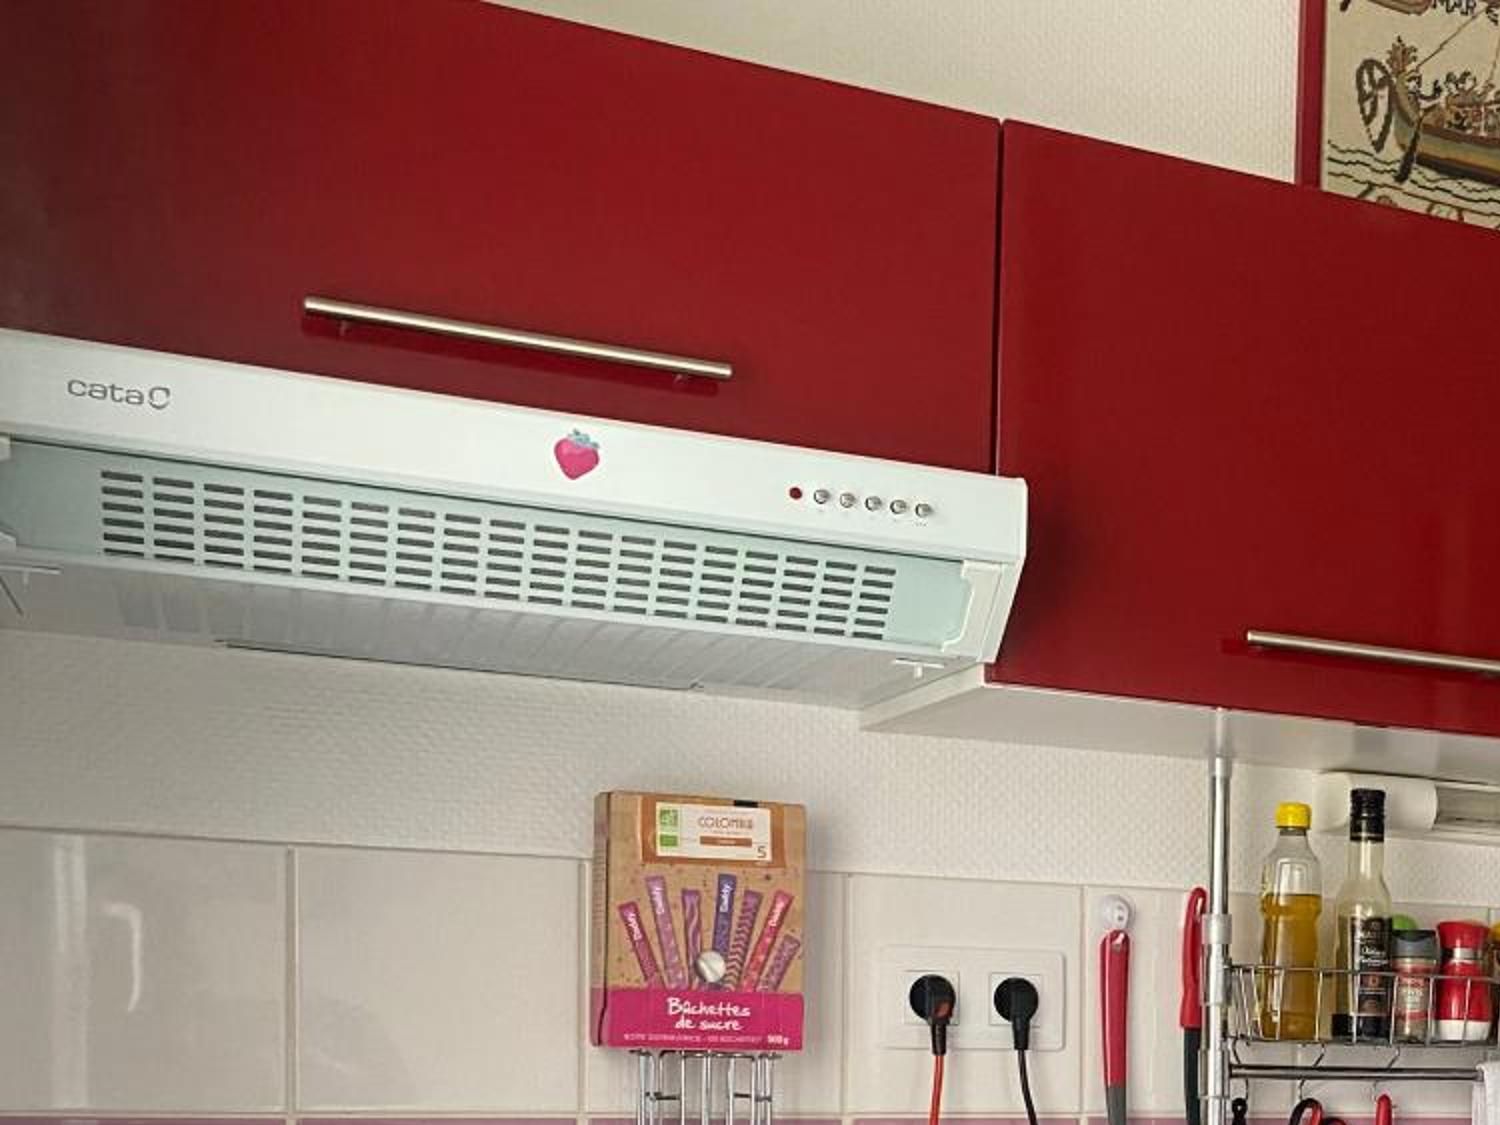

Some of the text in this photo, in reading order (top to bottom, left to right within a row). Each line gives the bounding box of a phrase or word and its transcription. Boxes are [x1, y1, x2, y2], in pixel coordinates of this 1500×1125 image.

[66, 379, 145, 405] cata
[667, 997, 751, 1017] Bûchettes
[674, 1017, 743, 1031] de sucre
